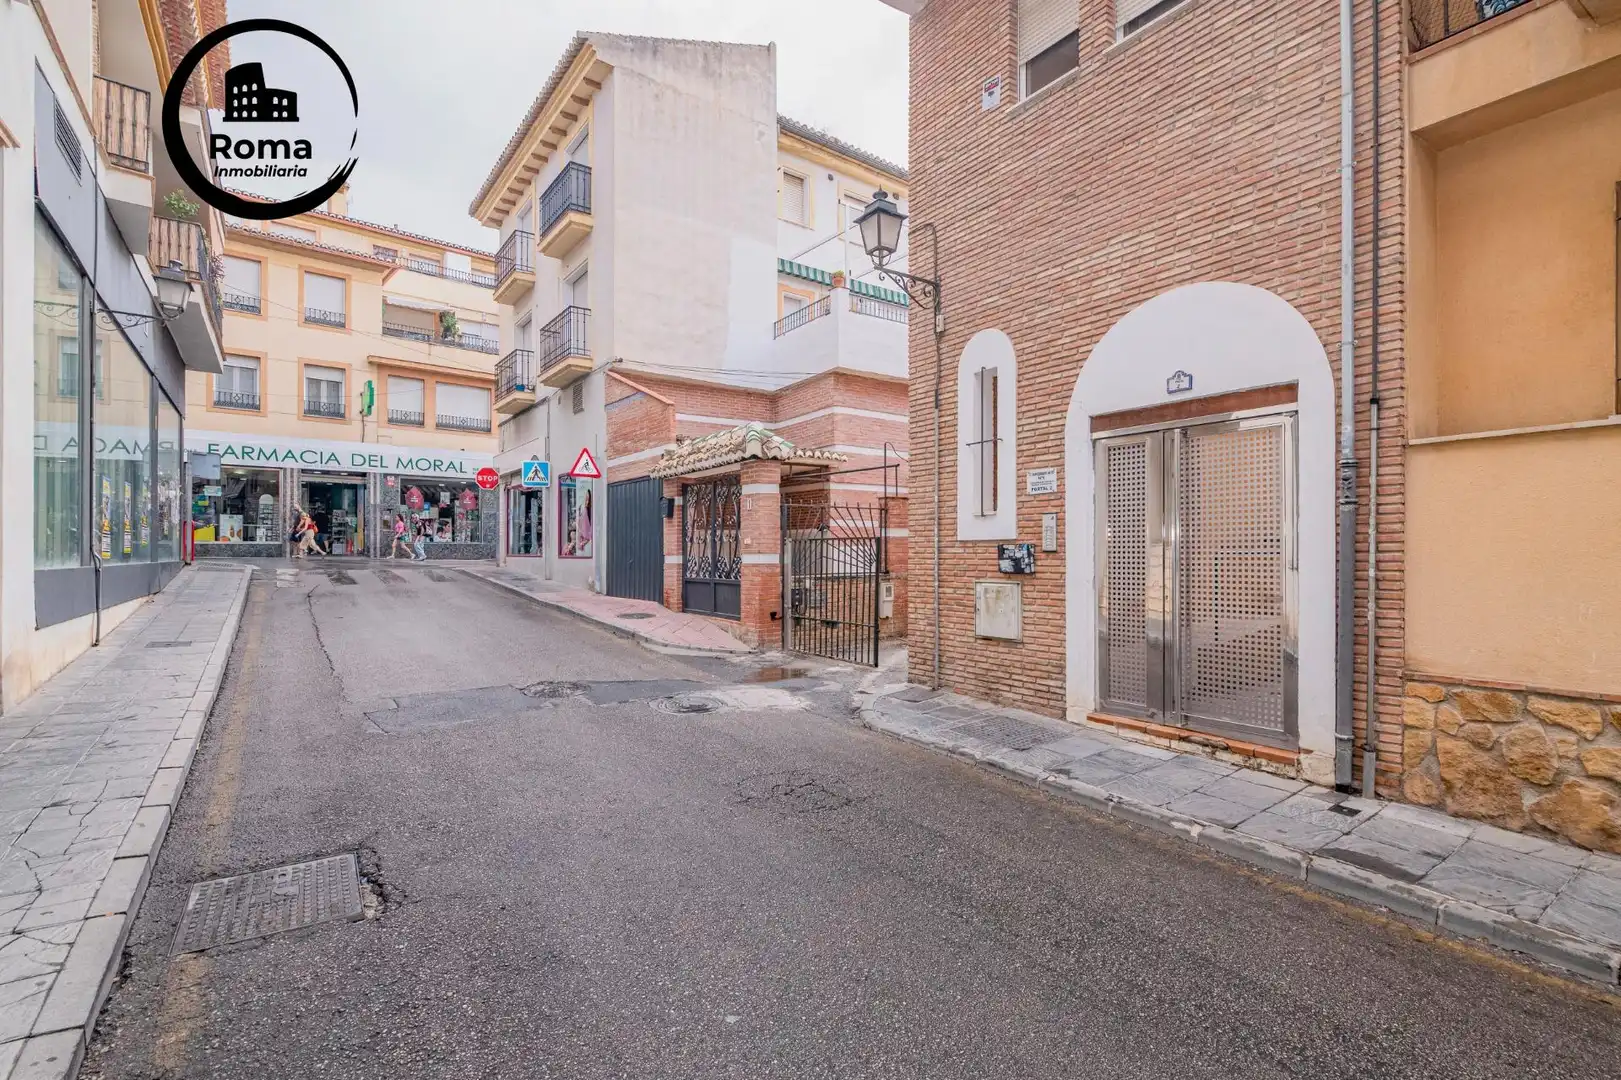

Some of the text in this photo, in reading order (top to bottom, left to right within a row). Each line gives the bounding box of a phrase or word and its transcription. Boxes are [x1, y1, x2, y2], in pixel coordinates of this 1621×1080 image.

[207, 443, 341, 465] FARMACIA
[351, 453, 388, 469] DEL
[396, 457, 468, 474] MORAL
